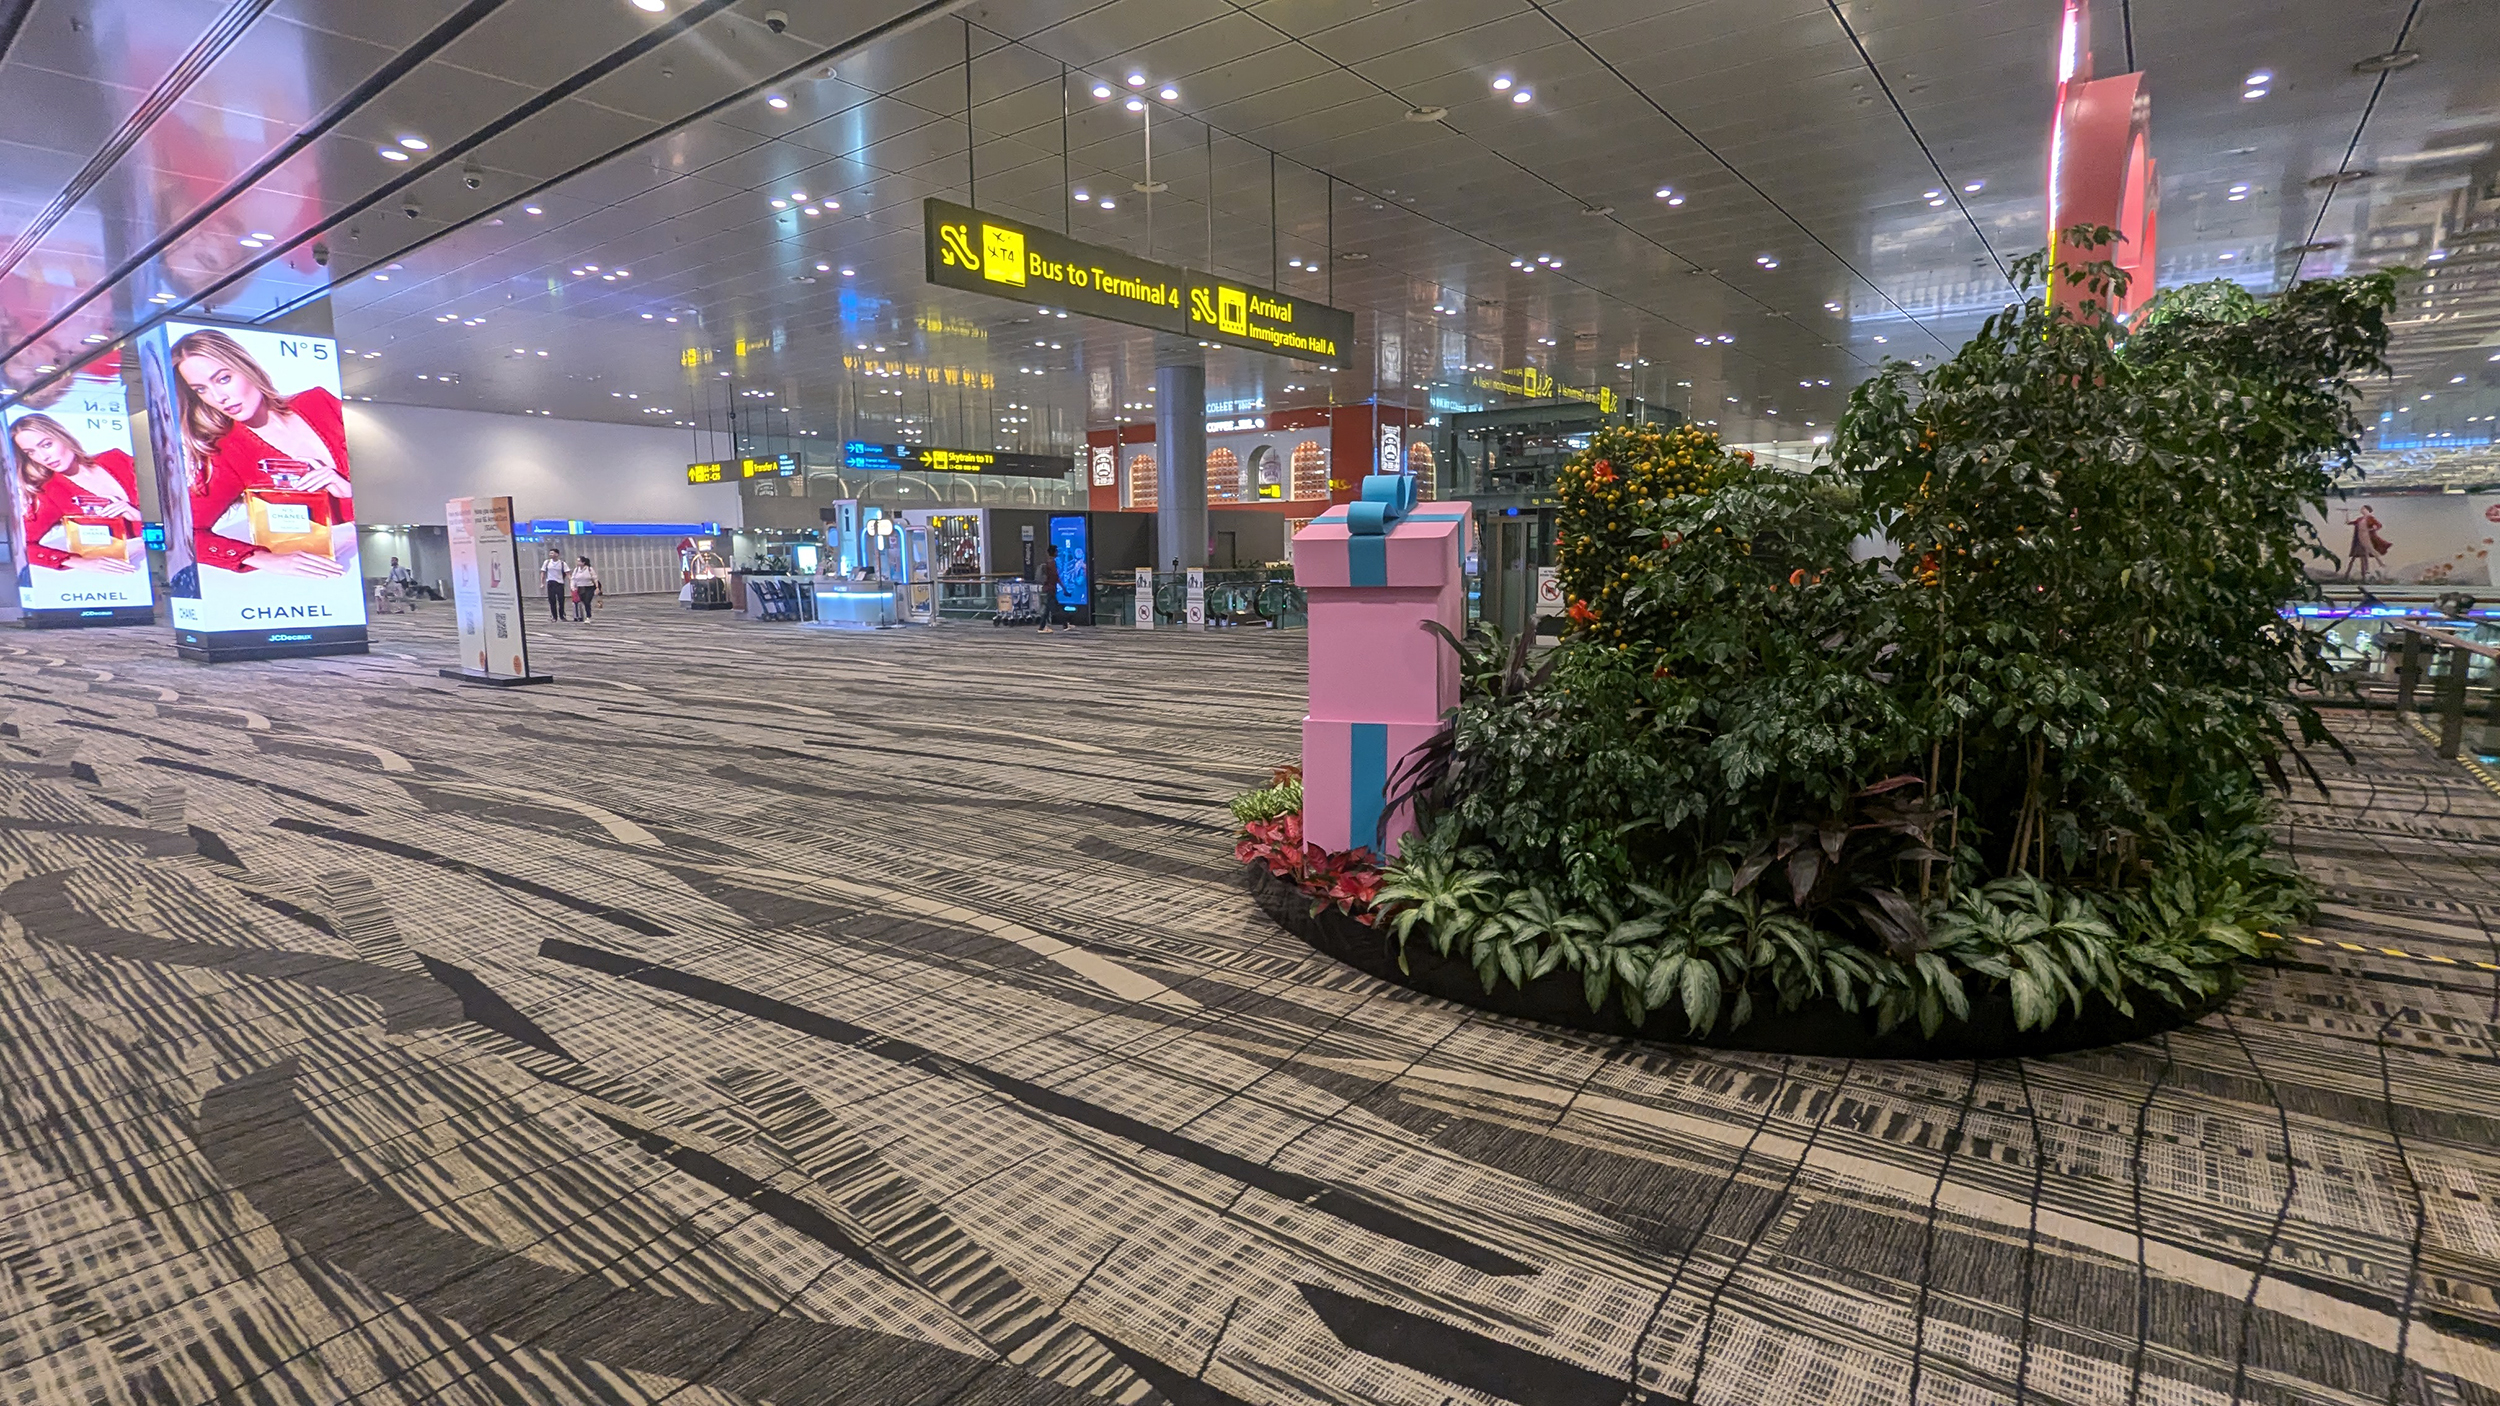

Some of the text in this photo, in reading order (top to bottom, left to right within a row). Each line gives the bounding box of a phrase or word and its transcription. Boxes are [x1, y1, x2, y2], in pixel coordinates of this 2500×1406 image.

[1000, 247, 1015, 263] T4
[1029, 252, 1180, 309] Bus to Terminal 4
[1249, 295, 1292, 323] Arrival
[1249, 323, 1336, 356] Immigration Hall A
[313, 344, 328, 360] 5
[112, 420, 122, 430] 5
[948, 452, 993, 464] Skytrain to T1
[773, 462, 778, 470] A
[60, 592, 128, 602] CHANEL
[241, 605, 333, 620] CHANEL
[268, 633, 313, 642] JCDecaux
